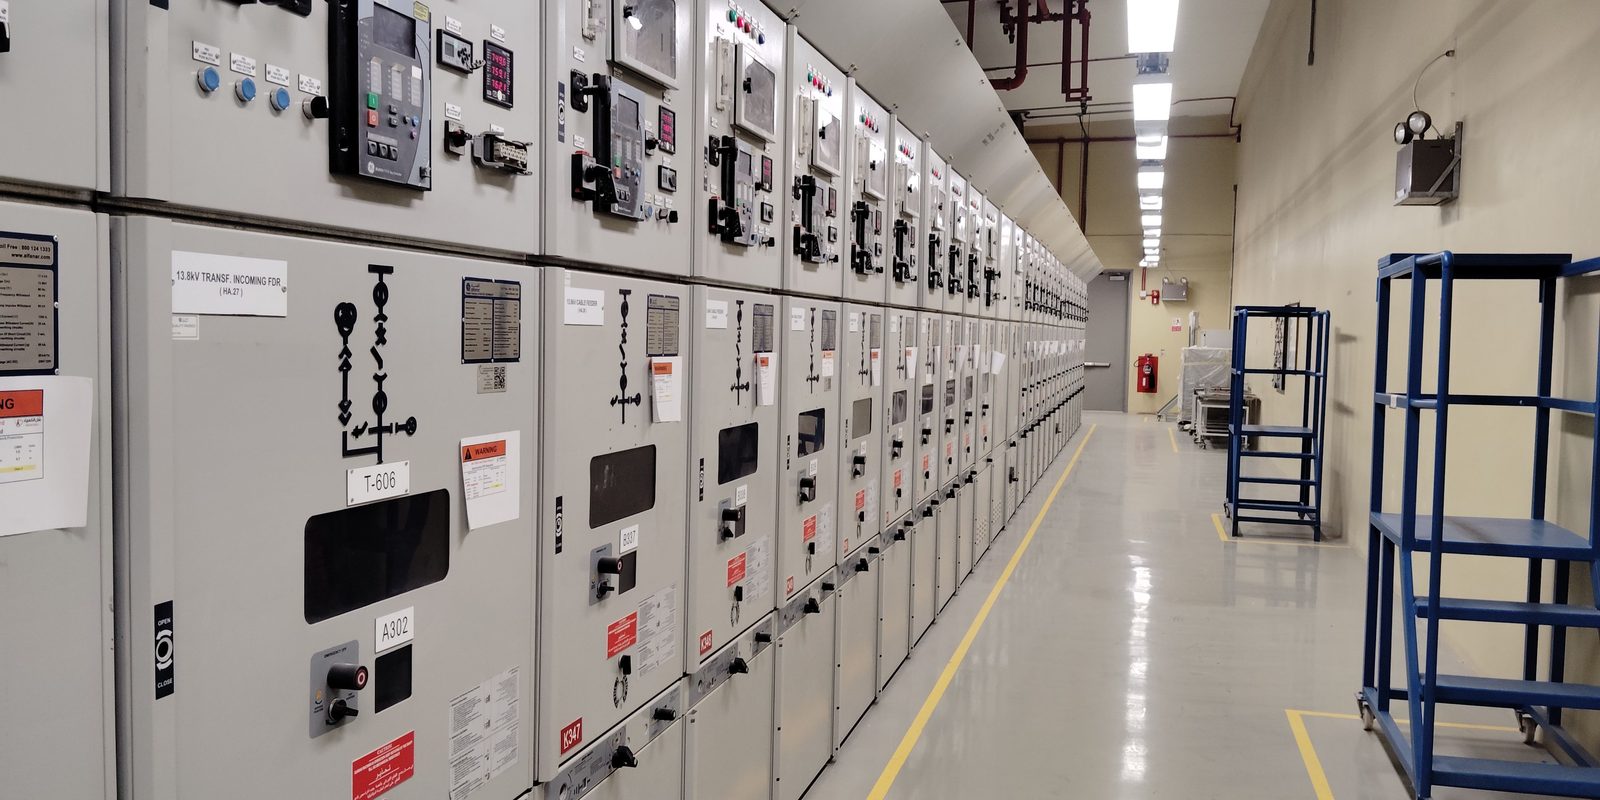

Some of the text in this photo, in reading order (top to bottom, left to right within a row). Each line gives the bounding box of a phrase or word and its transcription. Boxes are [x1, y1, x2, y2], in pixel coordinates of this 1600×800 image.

[176, 271, 281, 287] 13.8kV TRANSF. INCOMING FDR
[475, 445, 498, 456] WARNING
[364, 470, 397, 493] T-606
[158, 618, 171, 627] OPEN
[382, 616, 408, 643] A302
[157, 678, 173, 688] CLOSE
[563, 722, 581, 750] K347
